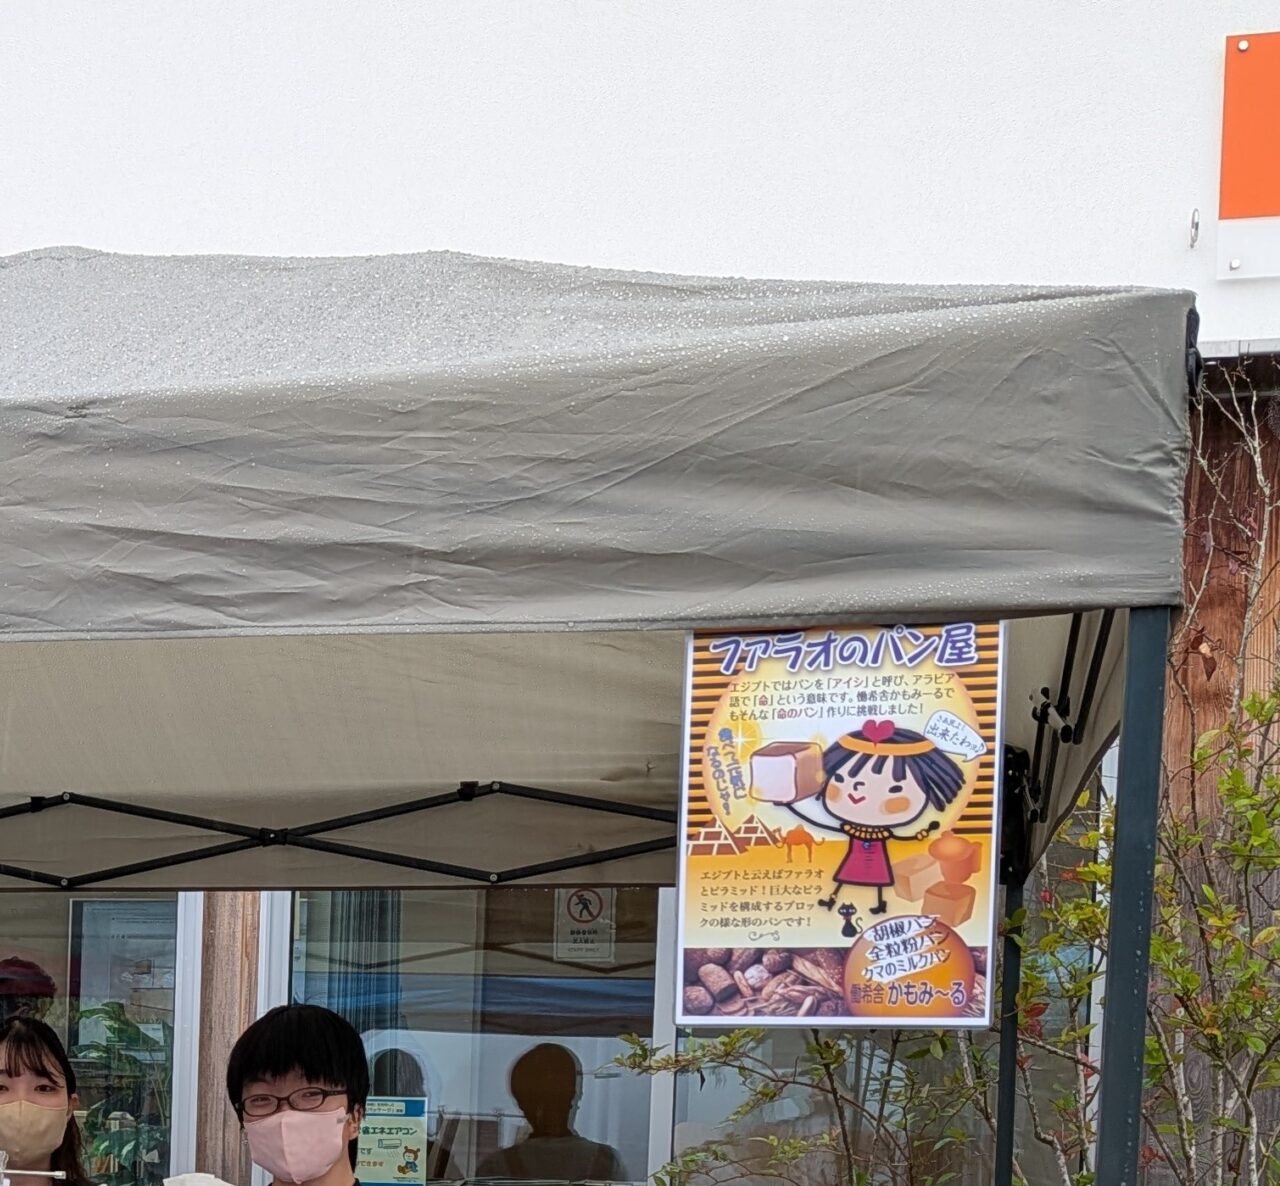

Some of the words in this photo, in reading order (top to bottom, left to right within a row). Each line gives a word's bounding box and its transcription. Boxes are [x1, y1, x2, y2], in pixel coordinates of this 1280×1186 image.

[711, 623, 978, 674] ファラオのパン屋
[701, 868, 824, 881] エジプトと云えばファラオ
[700, 884, 823, 897] とピラミッド!巨大なピラ
[700, 900, 816, 913] ミッドを構成するブロッ
[699, 916, 812, 929] クの様な形のパンです!
